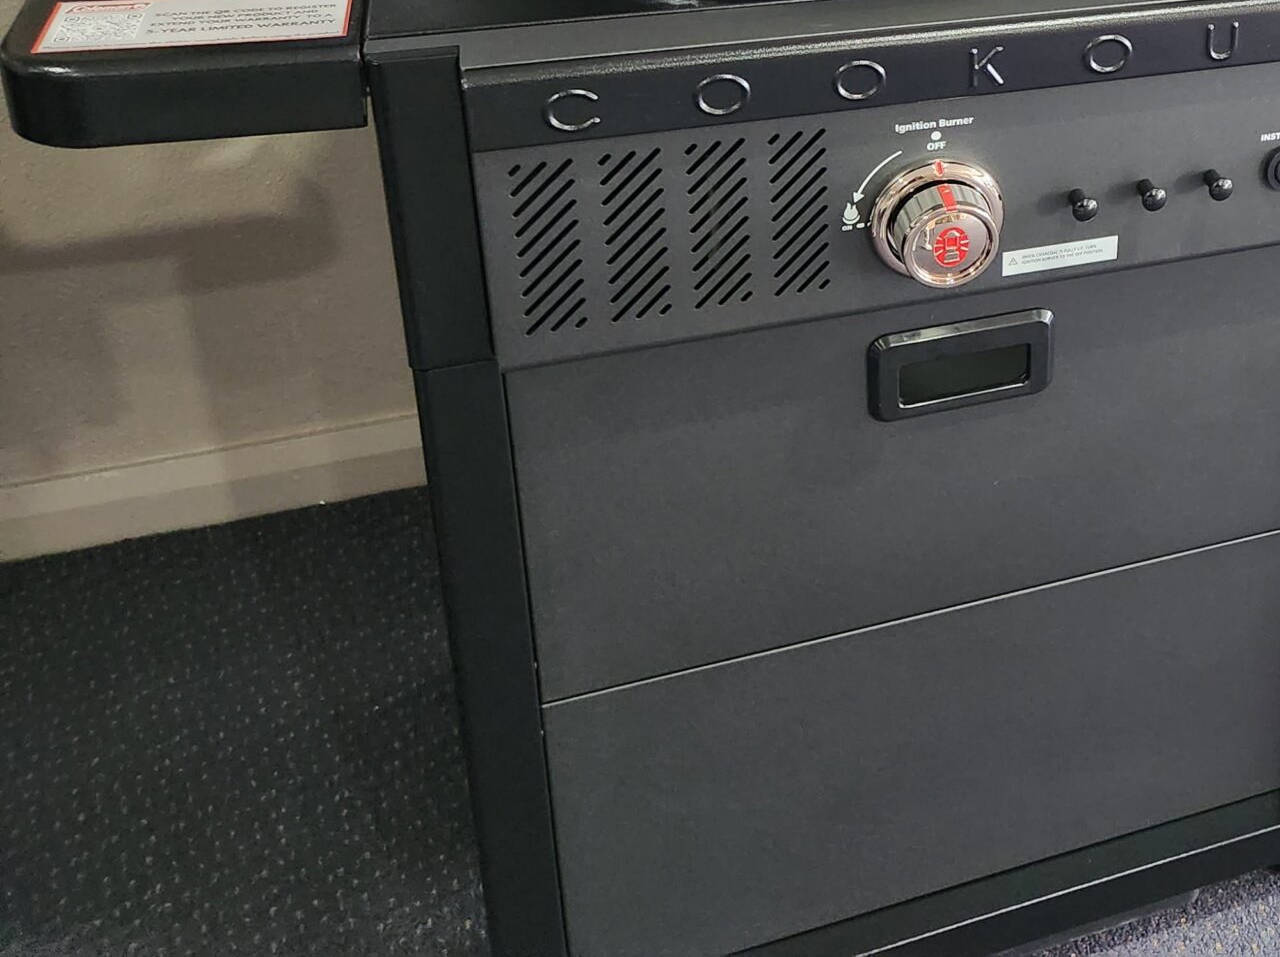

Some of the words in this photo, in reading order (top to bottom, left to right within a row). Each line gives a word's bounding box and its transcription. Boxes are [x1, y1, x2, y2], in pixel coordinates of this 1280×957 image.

[257, 19, 337, 28] WARRANTY
[895, 122, 937, 134] Ignition
[938, 117, 974, 128] Burner
[927, 141, 947, 151] OFF
